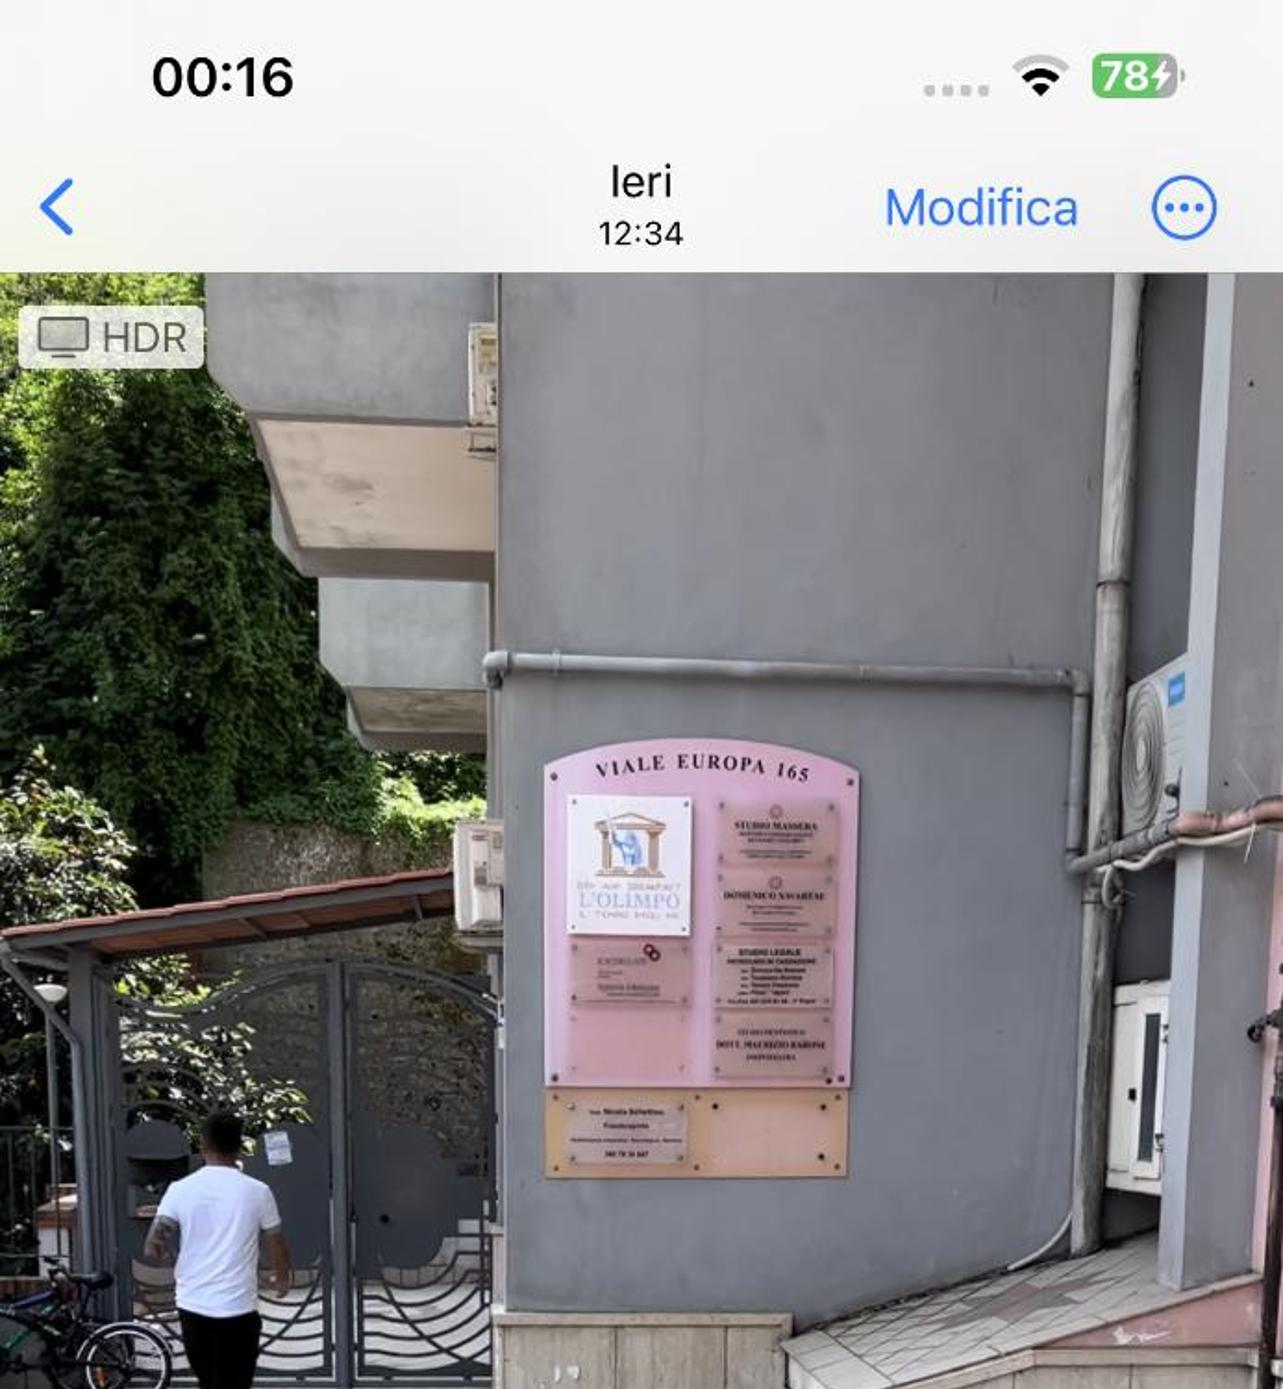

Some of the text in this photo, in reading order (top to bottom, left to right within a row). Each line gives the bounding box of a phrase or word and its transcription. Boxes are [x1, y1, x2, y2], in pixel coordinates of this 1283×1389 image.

[595, 753, 810, 783] VIALE EUROPA 165
[578, 891, 681, 909] L'OLIMPO
